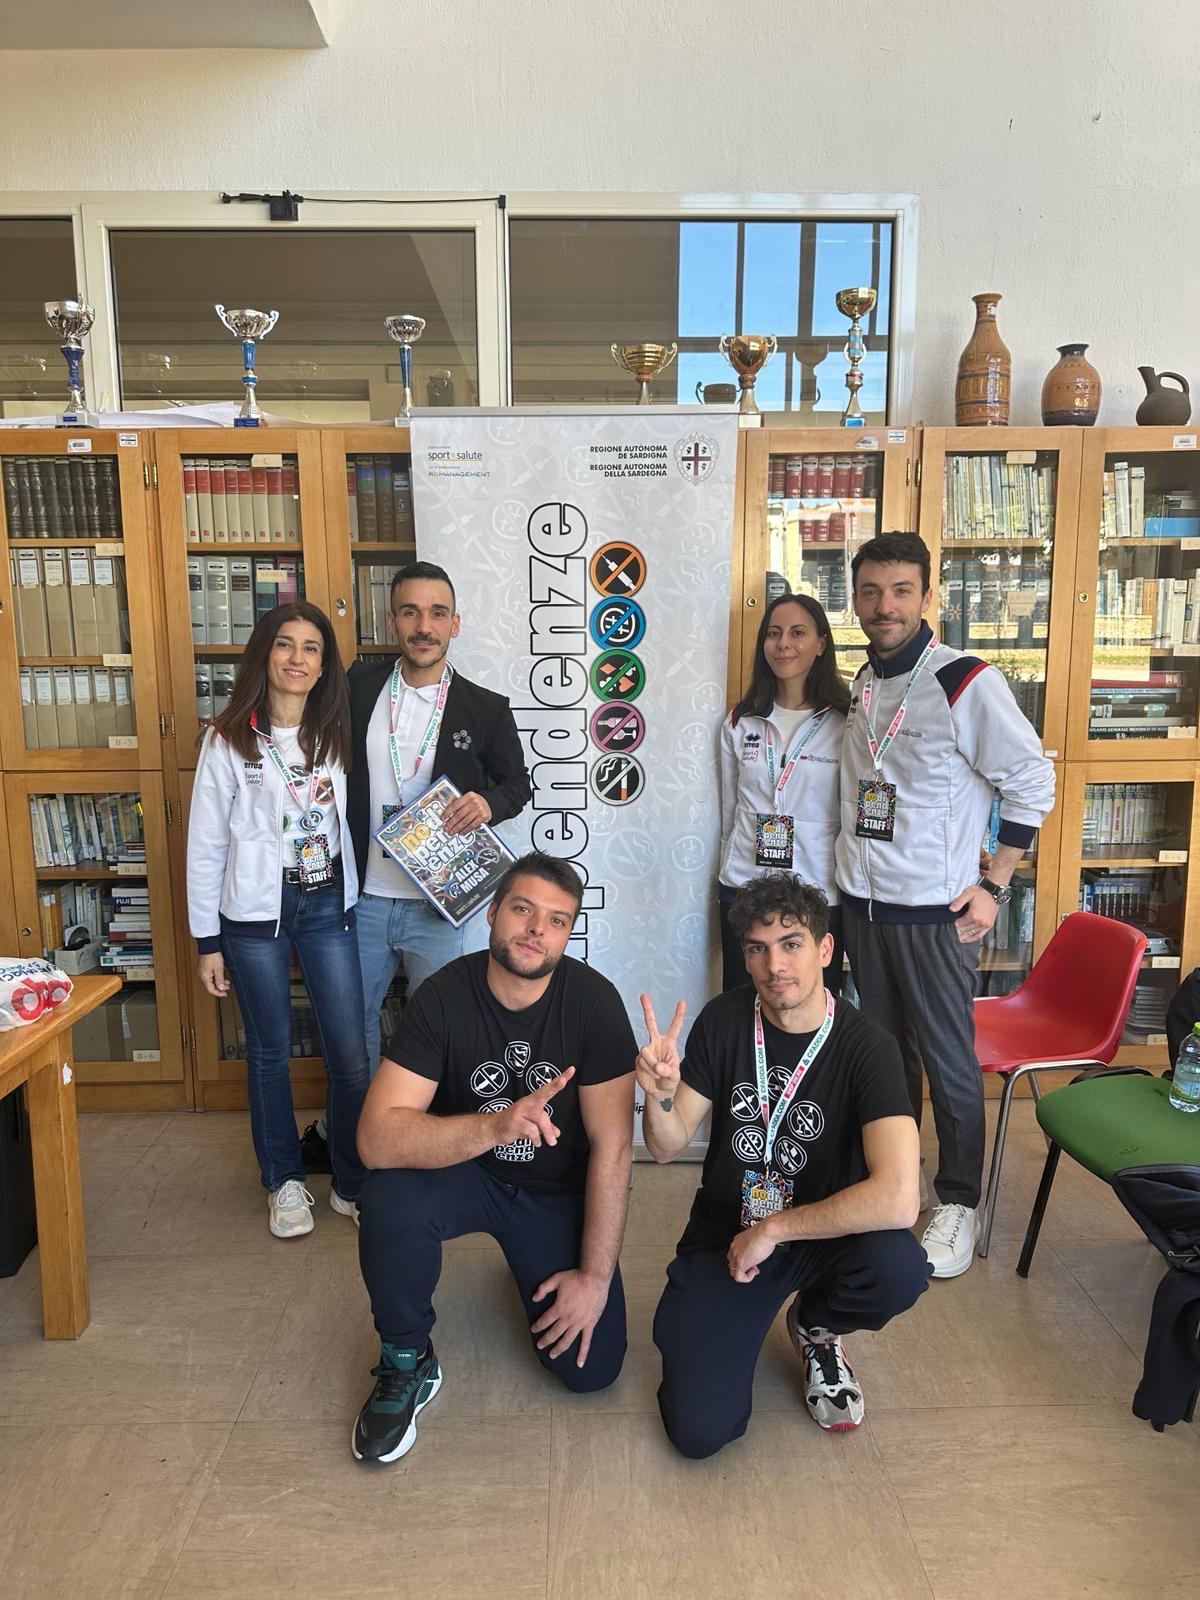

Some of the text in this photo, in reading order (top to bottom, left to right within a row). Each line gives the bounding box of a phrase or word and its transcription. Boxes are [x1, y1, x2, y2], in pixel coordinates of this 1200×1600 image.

[428, 451, 450, 461] sport
[457, 450, 482, 459] salute
[863, 818, 887, 831] STAFF
[427, 829, 477, 872] enze
[763, 848, 786, 860] STAFF
[454, 858, 480, 883] ALEX
[307, 871, 327, 884] STAFF
[460, 867, 490, 895] MUSA
[807, 1018, 831, 1058] CFADDA.COM
[757, 1047, 767, 1093] CFADDA.COM
[770, 1099, 787, 1138] CFADDA.COM
[494, 1144, 535, 1154] pend
[495, 1152, 535, 1162] enze
[752, 1187, 781, 1201] nodi
[752, 1199, 782, 1211] pend
